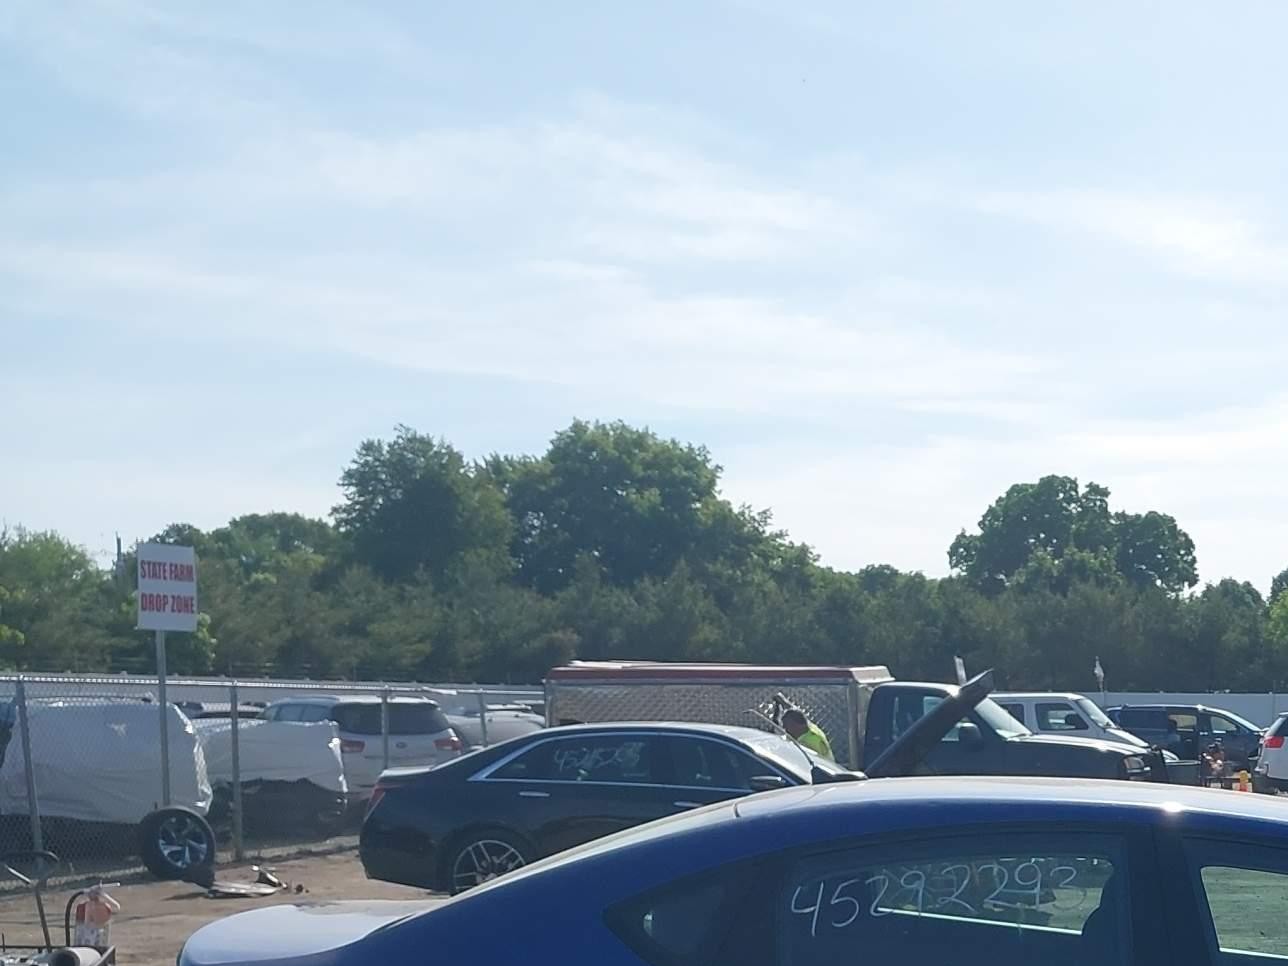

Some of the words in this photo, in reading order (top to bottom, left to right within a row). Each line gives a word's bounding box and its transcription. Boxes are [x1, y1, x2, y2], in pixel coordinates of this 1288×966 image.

[140, 560, 167, 580] STATE
[169, 562, 194, 582] FARM
[140, 592, 168, 612] DROP
[171, 594, 195, 614] ZONE
[791, 862, 1087, 937] 45292293
